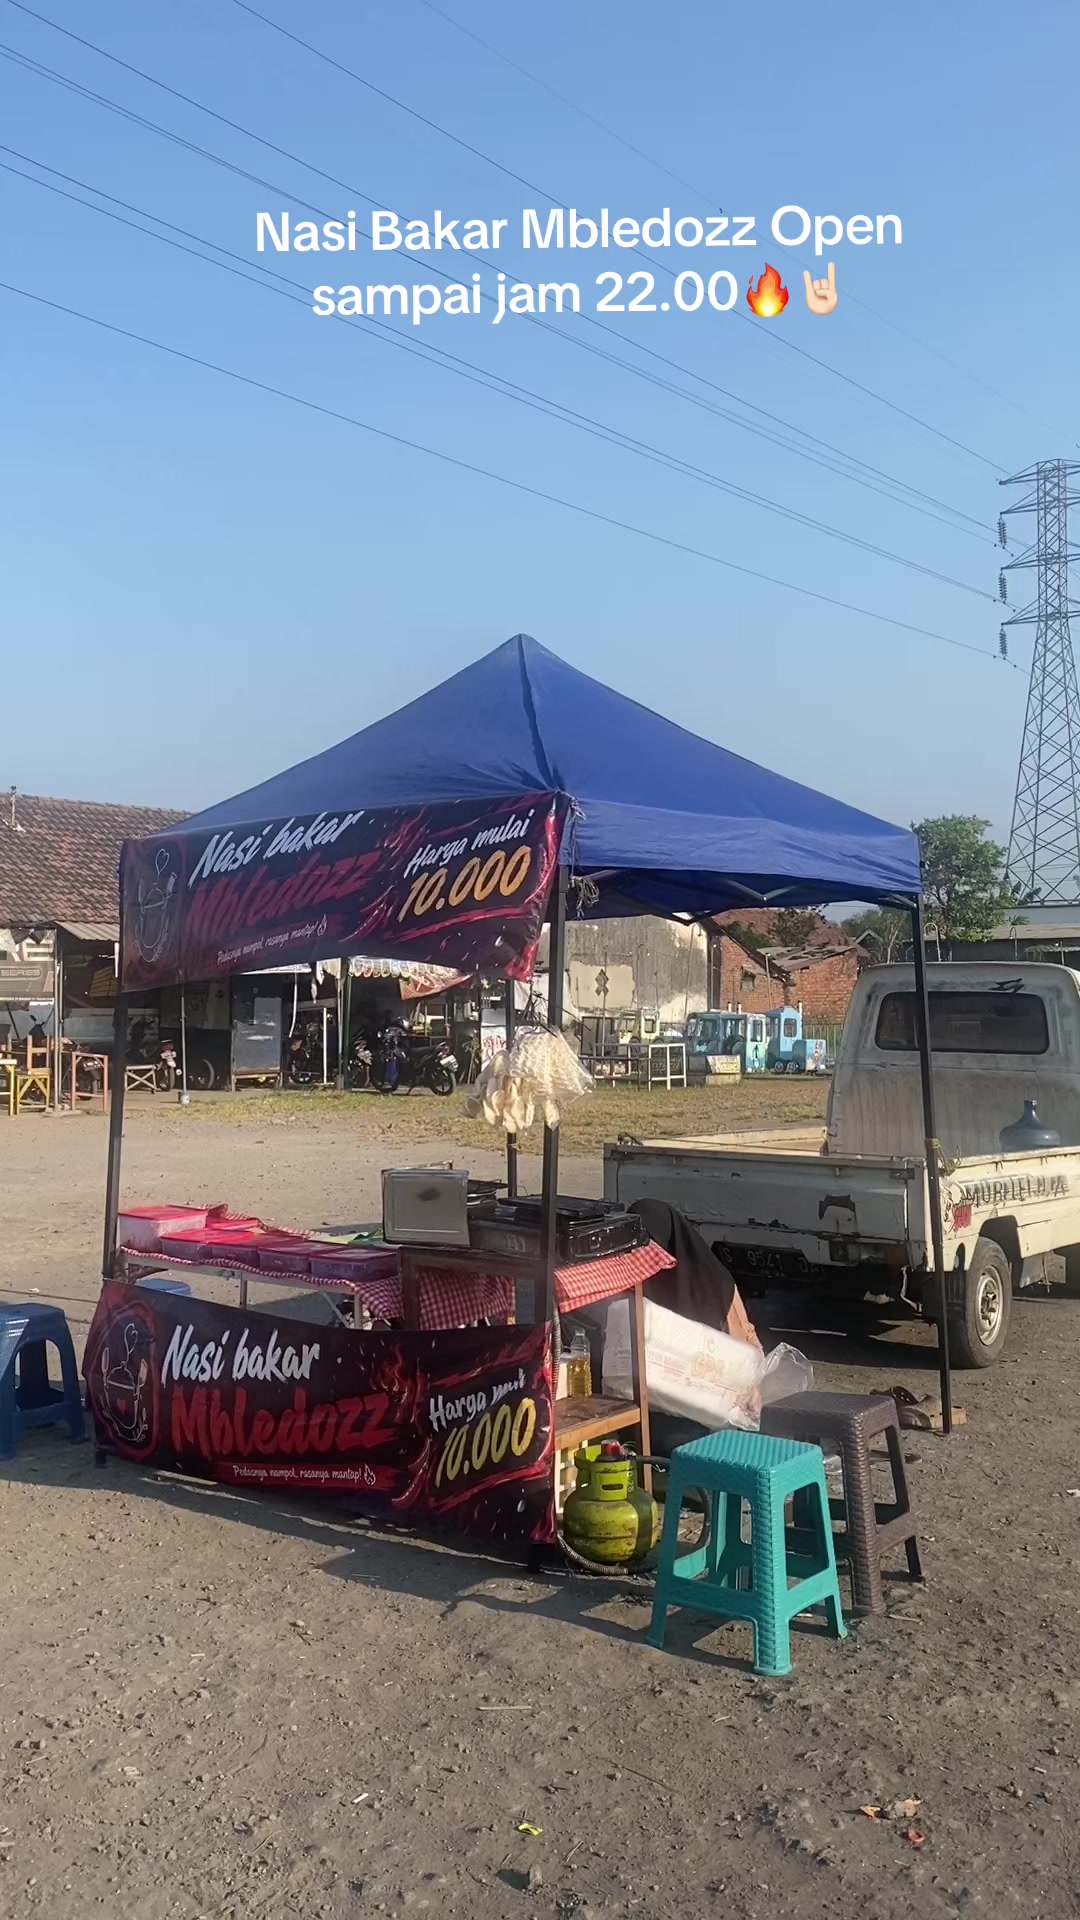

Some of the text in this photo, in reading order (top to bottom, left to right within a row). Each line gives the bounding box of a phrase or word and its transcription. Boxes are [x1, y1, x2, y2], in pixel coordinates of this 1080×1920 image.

[188, 811, 364, 889] Nasi bakar
[403, 808, 535, 879] Harga mulai
[184, 851, 382, 944] Mbledozz
[397, 845, 532, 922] 10.000
[161, 1324, 320, 1388] Nasi bakar
[171, 1384, 398, 1460] Mbledozz
[429, 1392, 486, 1432] Harga
[435, 1397, 536, 1489] 10.000
[232, 1465, 268, 1481] Pedasnya
[300, 1469, 330, 1483] rasanya
[332, 1467, 362, 1483] mantap!
